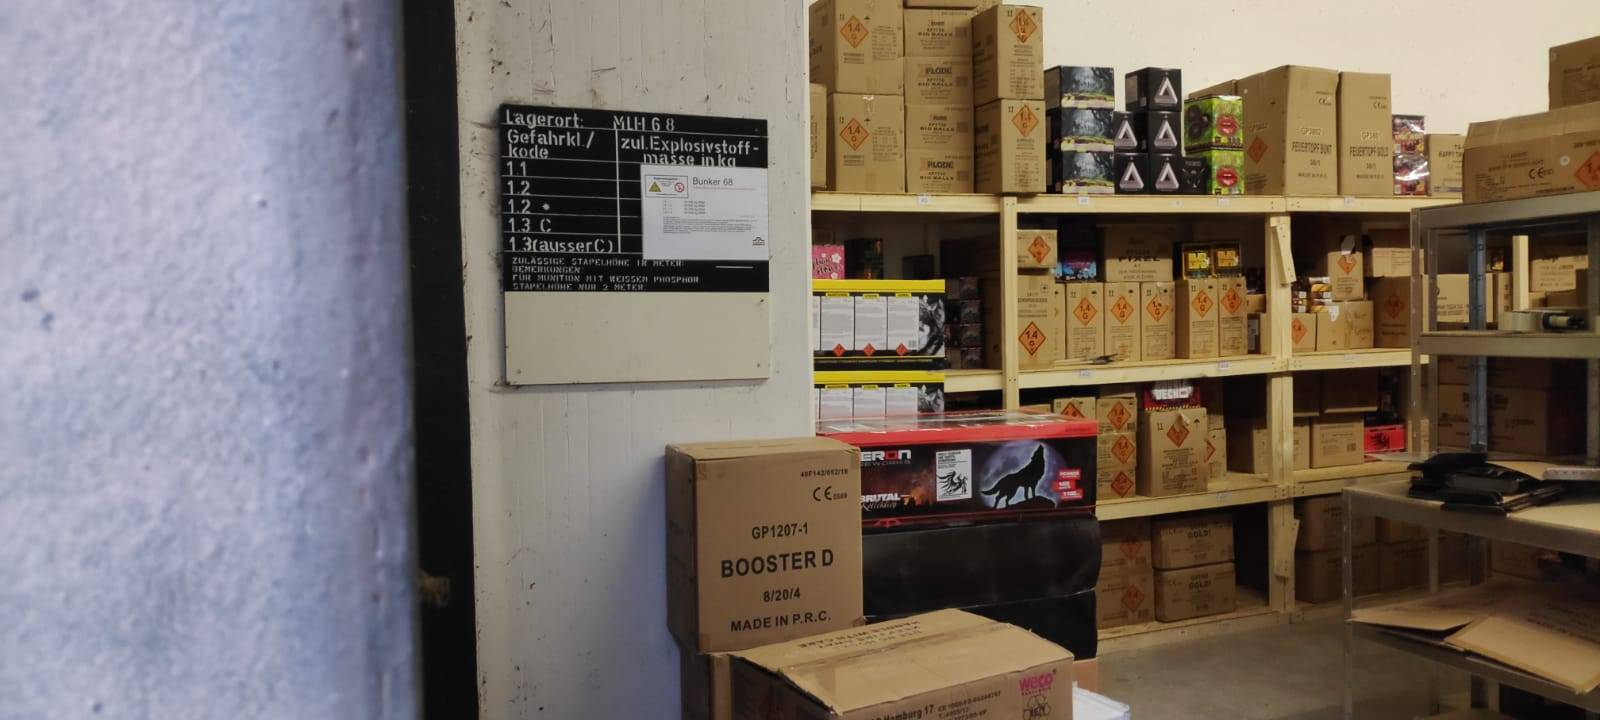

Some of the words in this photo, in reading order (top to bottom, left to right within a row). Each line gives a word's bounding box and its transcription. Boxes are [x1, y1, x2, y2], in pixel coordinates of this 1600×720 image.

[506, 109, 584, 129] Lagerort:
[508, 143, 549, 159] kode
[643, 153, 695, 167] masse
[507, 161, 527, 177] 1.1
[507, 180, 531, 195] 1.2
[692, 176, 721, 185] Bunker
[723, 178, 734, 186] 68
[508, 199, 531, 215] 1.2
[508, 217, 531, 233] 1.3
[540, 218, 552, 233] C
[751, 522, 808, 540] GP1207-1
[721, 550, 816, 578] BOOSTER
[822, 549, 834, 566] D
[763, 588, 800, 603] 8/20/4
[731, 616, 771, 632] MADE
[775, 615, 789, 627] IN
[793, 610, 831, 626] P.R.C.
[1018, 671, 1053, 690] weco
[925, 704, 934, 715] 17
